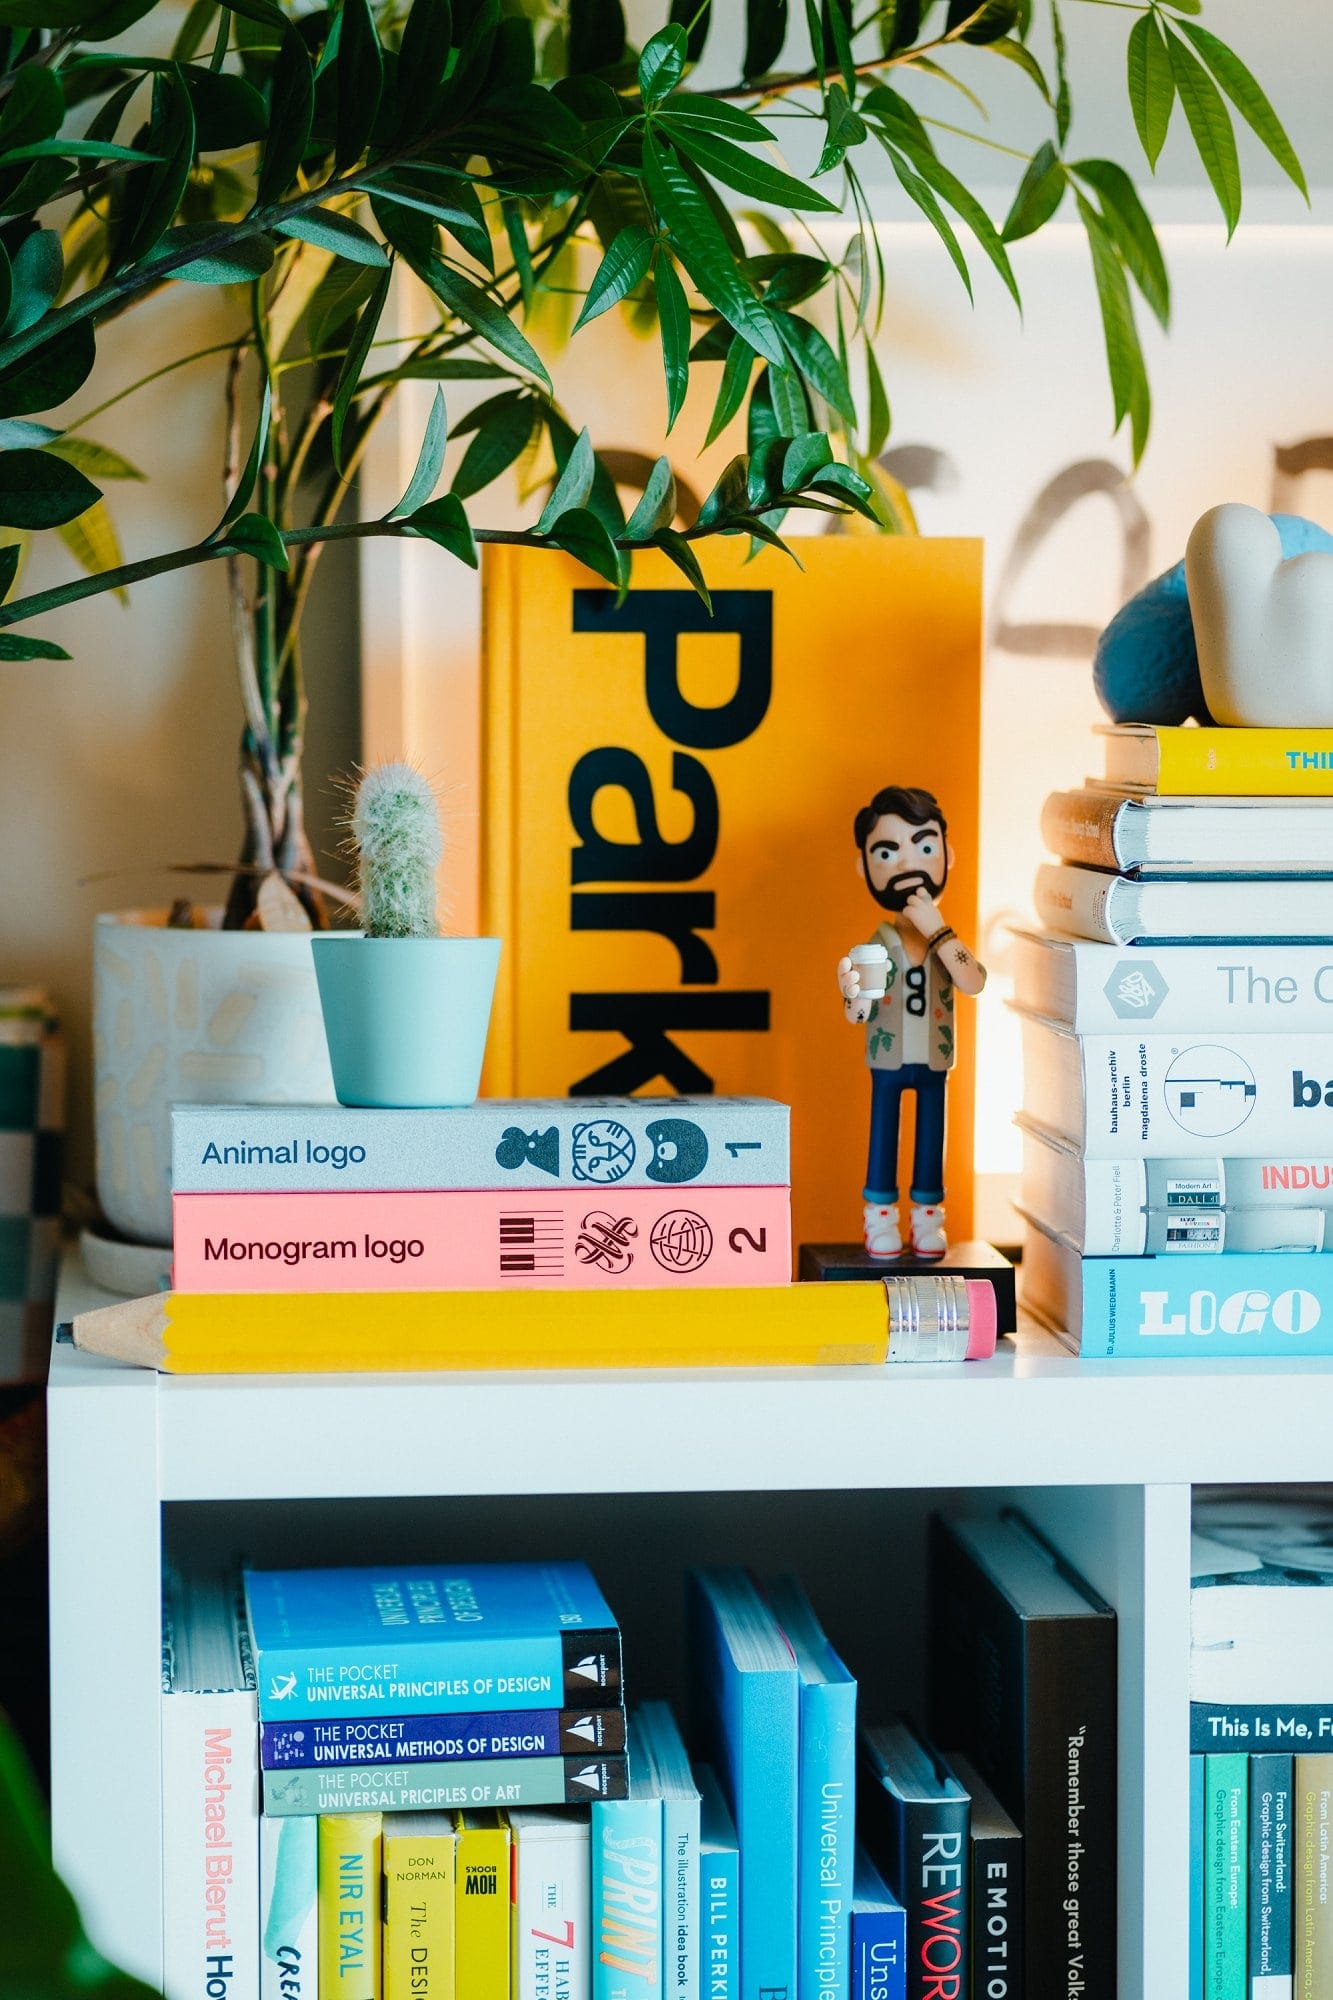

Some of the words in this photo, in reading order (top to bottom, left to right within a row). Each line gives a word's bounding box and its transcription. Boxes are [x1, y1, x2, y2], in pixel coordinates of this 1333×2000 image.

[567, 589, 773, 1097] Park
[1217, 966, 1297, 1004] The
[1139, 1043, 1147, 1077] droste
[1109, 1050, 1118, 1134] bauhaus-archiv
[1123, 1076, 1131, 1107] berlin
[1140, 1081, 1150, 1140] magdalena
[201, 1140, 298, 1165] Animal
[306, 1139, 366, 1170] logo
[725, 1141, 761, 1159] 1
[1112, 1165, 1120, 1183] Fiell
[1262, 1165, 1333, 1190] INDU
[1113, 1184, 1121, 1207] Peter
[204, 1236, 357, 1265] Monogram
[364, 1234, 424, 1265] logo
[728, 1227, 766, 1253] 2
[1111, 1216, 1121, 1252] Charlotte
[1139, 1289, 1321, 1336] LOGO
[1108, 1318, 1116, 1344] JULIUS
[306, 1683, 385, 1702] UNIVERSAL
[389, 1679, 469, 1698] PRINCIPLES
[473, 1679, 493, 1694] OF
[497, 1676, 551, 1693] DESIGN
[307, 1666, 335, 1682] THE
[339, 1664, 399, 1682] POCKET
[313, 1727, 342, 1742] THE
[346, 1723, 405, 1742] POCKET
[1208, 1717, 1249, 1737] This
[1255, 1717, 1270, 1737] Is
[1276, 1717, 1313, 1740] Me,
[1318, 1717, 1333, 1737] F
[313, 1742, 393, 1761] UNIVERSAL
[395, 1739, 464, 1757] METHODS
[467, 1739, 487, 1753] OF
[491, 1735, 545, 1752] DESIGN
[204, 1728, 232, 1848] Michael
[318, 1774, 344, 1789] THE
[349, 1771, 409, 1788] POCKET
[318, 1789, 396, 1808] UNIVERSAL
[400, 1786, 468, 1805] PRICIPLES
[471, 1786, 491, 1801] OF
[495, 1784, 521, 1800] ART
[1214, 1789, 1227, 1836] Graphic
[1231, 1788, 1241, 1817] From
[1261, 1792, 1273, 1837] Graphic
[1276, 1792, 1287, 1821] From
[1304, 1792, 1316, 1837] Graphic
[1320, 1791, 1330, 1820] From
[677, 1833, 689, 1856] The
[820, 1782, 843, 1887] Universal
[1230, 1821, 1240, 1863] Eastern
[1320, 1823, 1330, 1852] Latin
[408, 1857, 434, 1867] DON
[1068, 1843, 1085, 1892] those
[1214, 1839, 1227, 1873] design
[1260, 1840, 1272, 1874] design
[1276, 1824, 1287, 1893] Switzerland:
[1304, 1840, 1315, 1873] design
[339, 1855, 363, 1900] NIR
[397, 1871, 446, 1881] NORMAN
[465, 1875, 497, 1895] HOW
[677, 1859, 689, 1921] illustration
[1216, 1876, 1226, 1903] from
[1229, 1866, 1240, 1910] Europe:
[1262, 1875, 1272, 1905] from
[1305, 1876, 1315, 1905] from
[1319, 1854, 1330, 1905] America:
[205, 1855, 232, 1949] Bierut
[547, 1884, 556, 1908] THE
[600, 1826, 657, 1984] SPRINT
[711, 1877, 727, 1925] BILL
[410, 1902, 427, 1938] The
[531, 1920, 574, 1949] 7
[987, 1863, 1007, 1999] EMOTIO
[1063, 1900, 1082, 1949] great
[1216, 1906, 1226, 1949] Eastern
[1305, 1908, 1314, 1936] Latin
[339, 1912, 364, 1977] EYAL
[677, 1924, 689, 1954] idea
[1260, 1907, 1272, 1975] Switzerland,
[207, 1956, 233, 2000] Ho
[411, 1948, 428, 2000] DESI
[536, 1949, 549, 2000] EFFE
[677, 1956, 689, 1986] book
